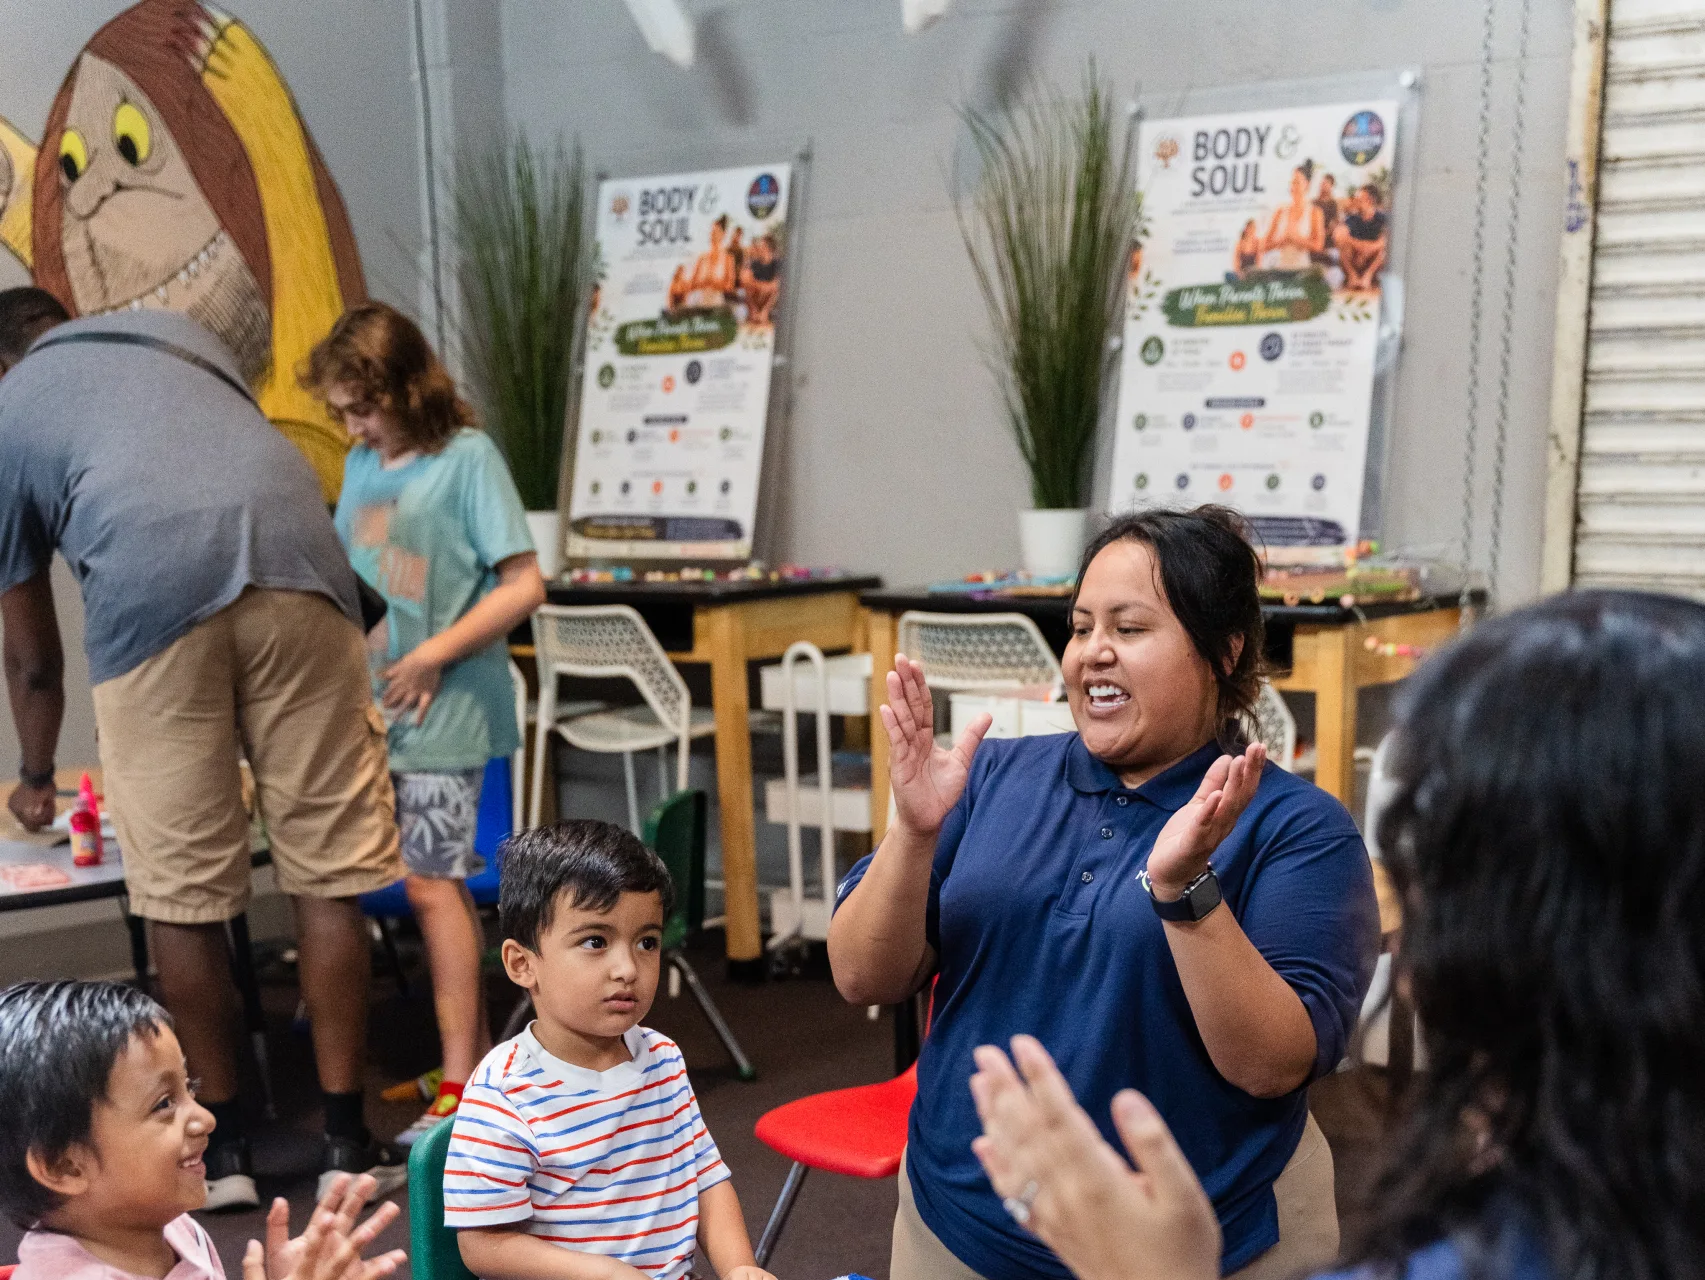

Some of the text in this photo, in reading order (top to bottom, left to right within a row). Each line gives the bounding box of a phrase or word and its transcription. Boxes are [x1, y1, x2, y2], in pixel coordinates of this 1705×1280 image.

[1193, 126, 1271, 161] BODY
[1274, 126, 1301, 159] &
[1190, 163, 1265, 197] SOUL
[638, 187, 698, 216] BODY
[636, 216, 691, 246] SOUL
